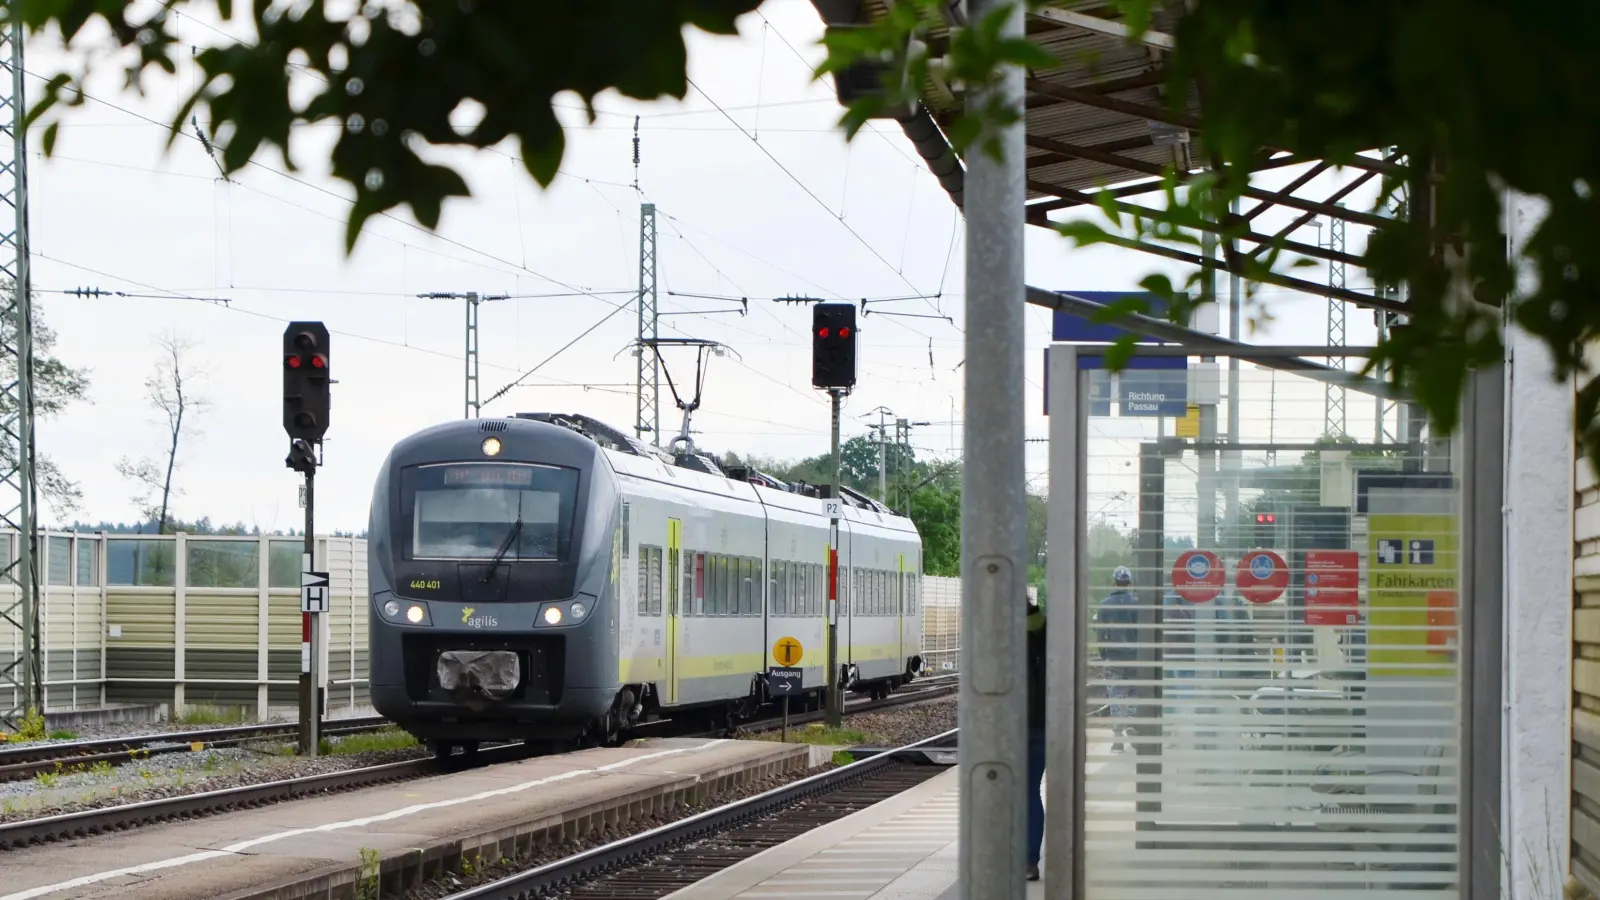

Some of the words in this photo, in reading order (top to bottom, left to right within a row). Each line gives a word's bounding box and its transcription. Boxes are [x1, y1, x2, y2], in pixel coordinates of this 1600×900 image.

[1128, 391, 1165, 401] Richtung
[1128, 402, 1159, 411] Passau
[827, 503, 838, 513] P2
[410, 580, 425, 589] 440
[426, 580, 440, 589] 401
[1376, 573, 1454, 588] Fahrkarten
[307, 588, 322, 610] H
[468, 616, 498, 628] agilis
[771, 670, 801, 679] Ausgang
